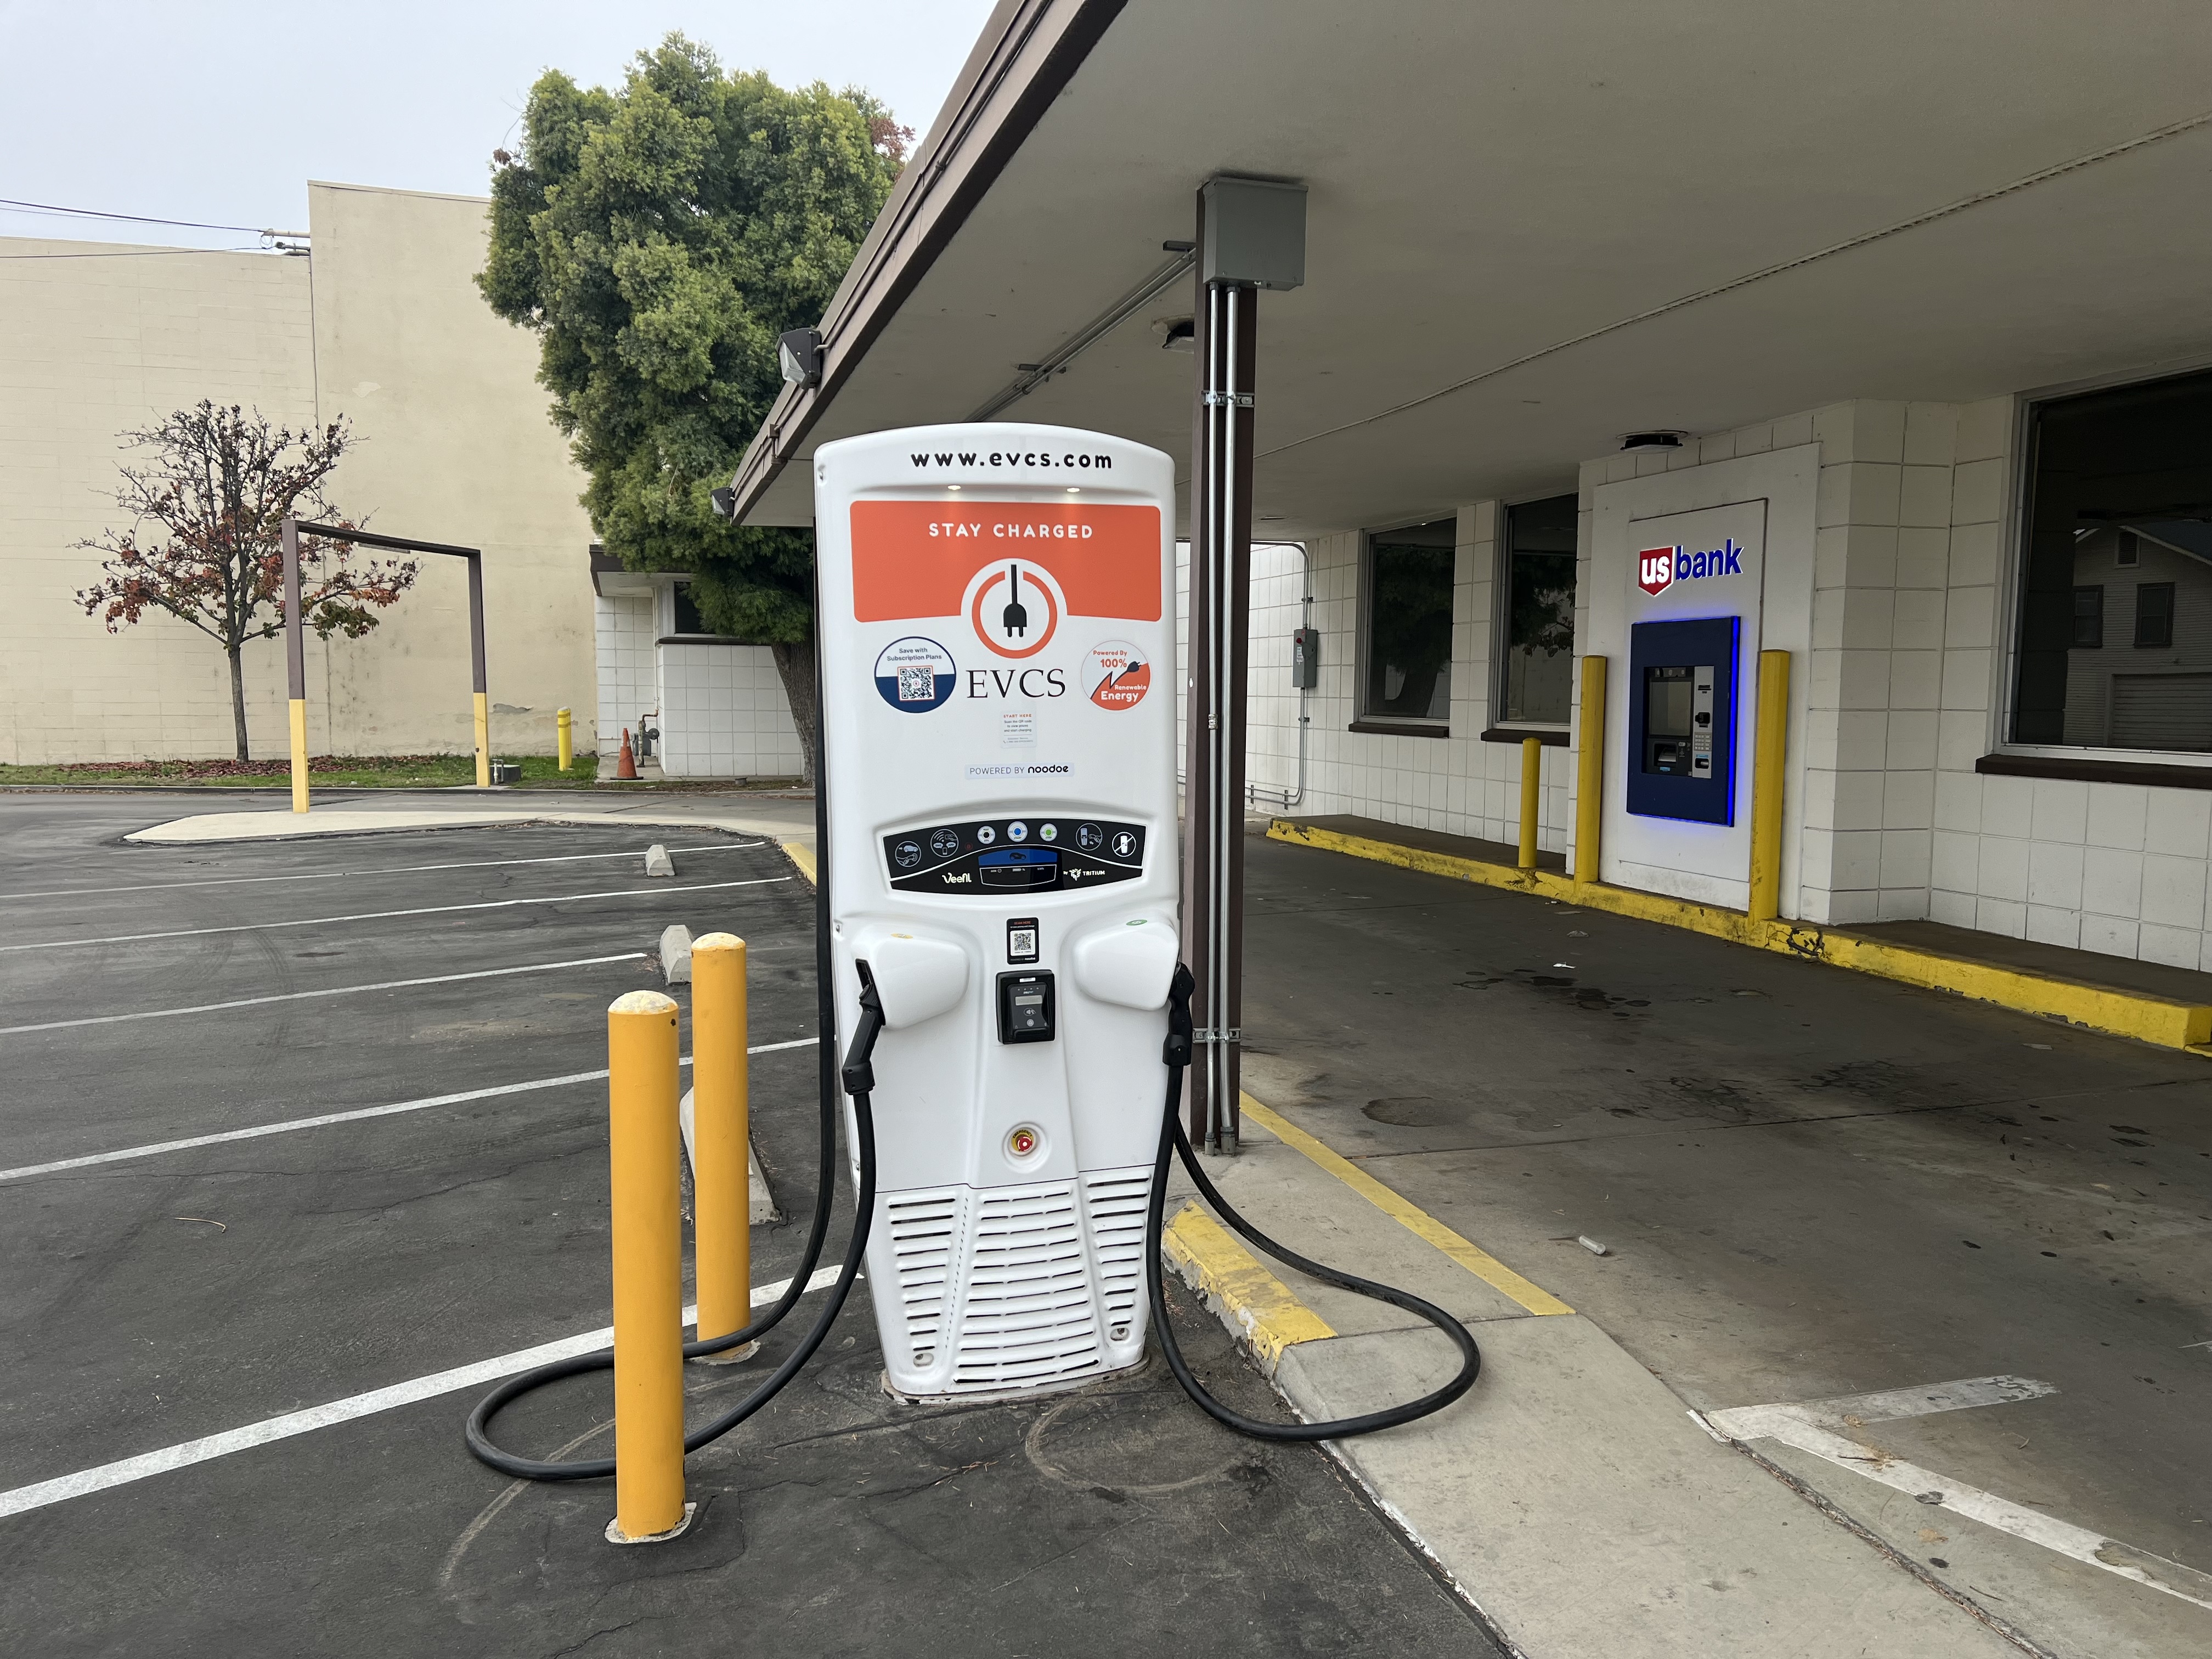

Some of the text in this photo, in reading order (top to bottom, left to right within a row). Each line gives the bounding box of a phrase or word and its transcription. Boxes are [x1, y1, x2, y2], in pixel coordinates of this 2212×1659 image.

[911, 451, 1113, 469] www.evcs.com
[929, 522, 1093, 539] STAY CHARGED
[1675, 538, 1745, 580] bank
[1100, 658, 1127, 668] 100%
[966, 668, 1065, 698] EVCS
[1101, 691, 1139, 702] Energy
[1028, 764, 1069, 774] noodoe
